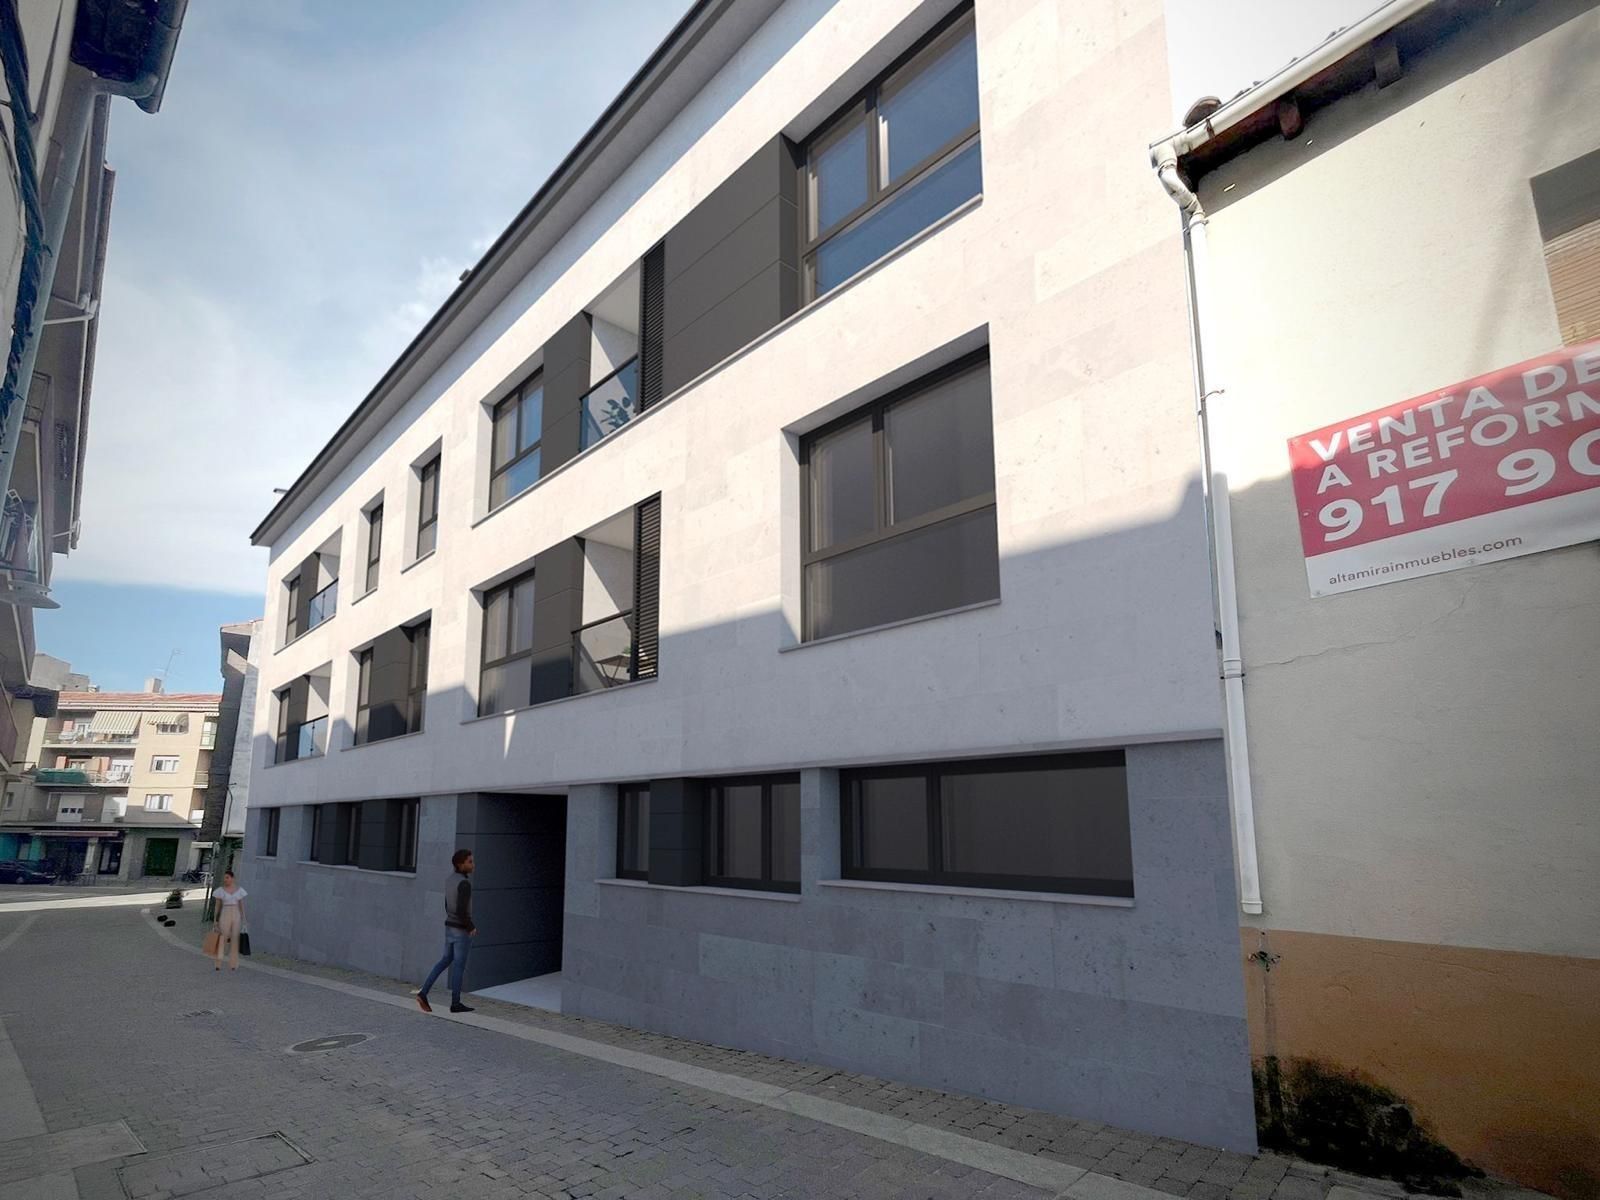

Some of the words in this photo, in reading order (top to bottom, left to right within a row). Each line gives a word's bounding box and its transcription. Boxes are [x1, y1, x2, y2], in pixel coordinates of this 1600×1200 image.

[1308, 386, 1505, 461] VENTA
[1521, 349, 1600, 400] DE
[1316, 464, 1352, 495] A
[1318, 469, 1458, 542] 917
[1329, 536, 1523, 586] altamirainmuebles.com
